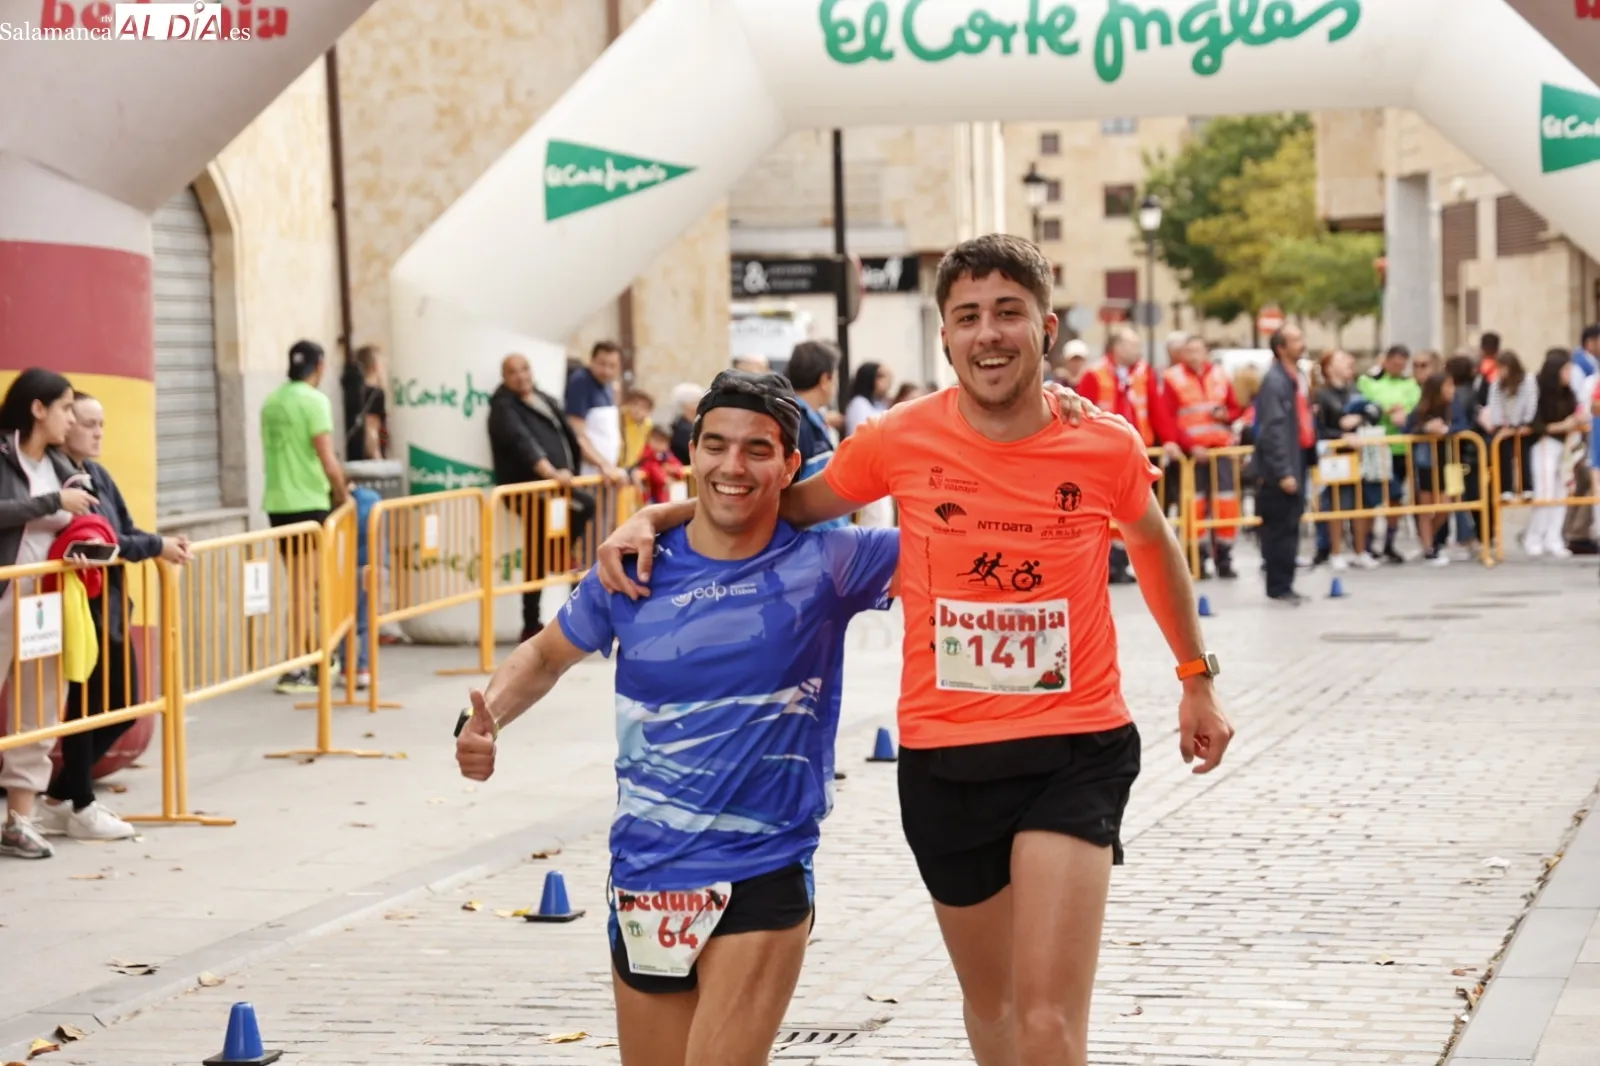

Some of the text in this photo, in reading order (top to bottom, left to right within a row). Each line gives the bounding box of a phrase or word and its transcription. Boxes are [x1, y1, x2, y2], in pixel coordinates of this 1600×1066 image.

[902, 0, 1080, 62] Corte
[977, 520, 1000, 531] NTT
[693, 581, 727, 602] edp
[940, 604, 1065, 632] bedunia
[967, 635, 1036, 669] 141
[658, 916, 699, 949] 64
